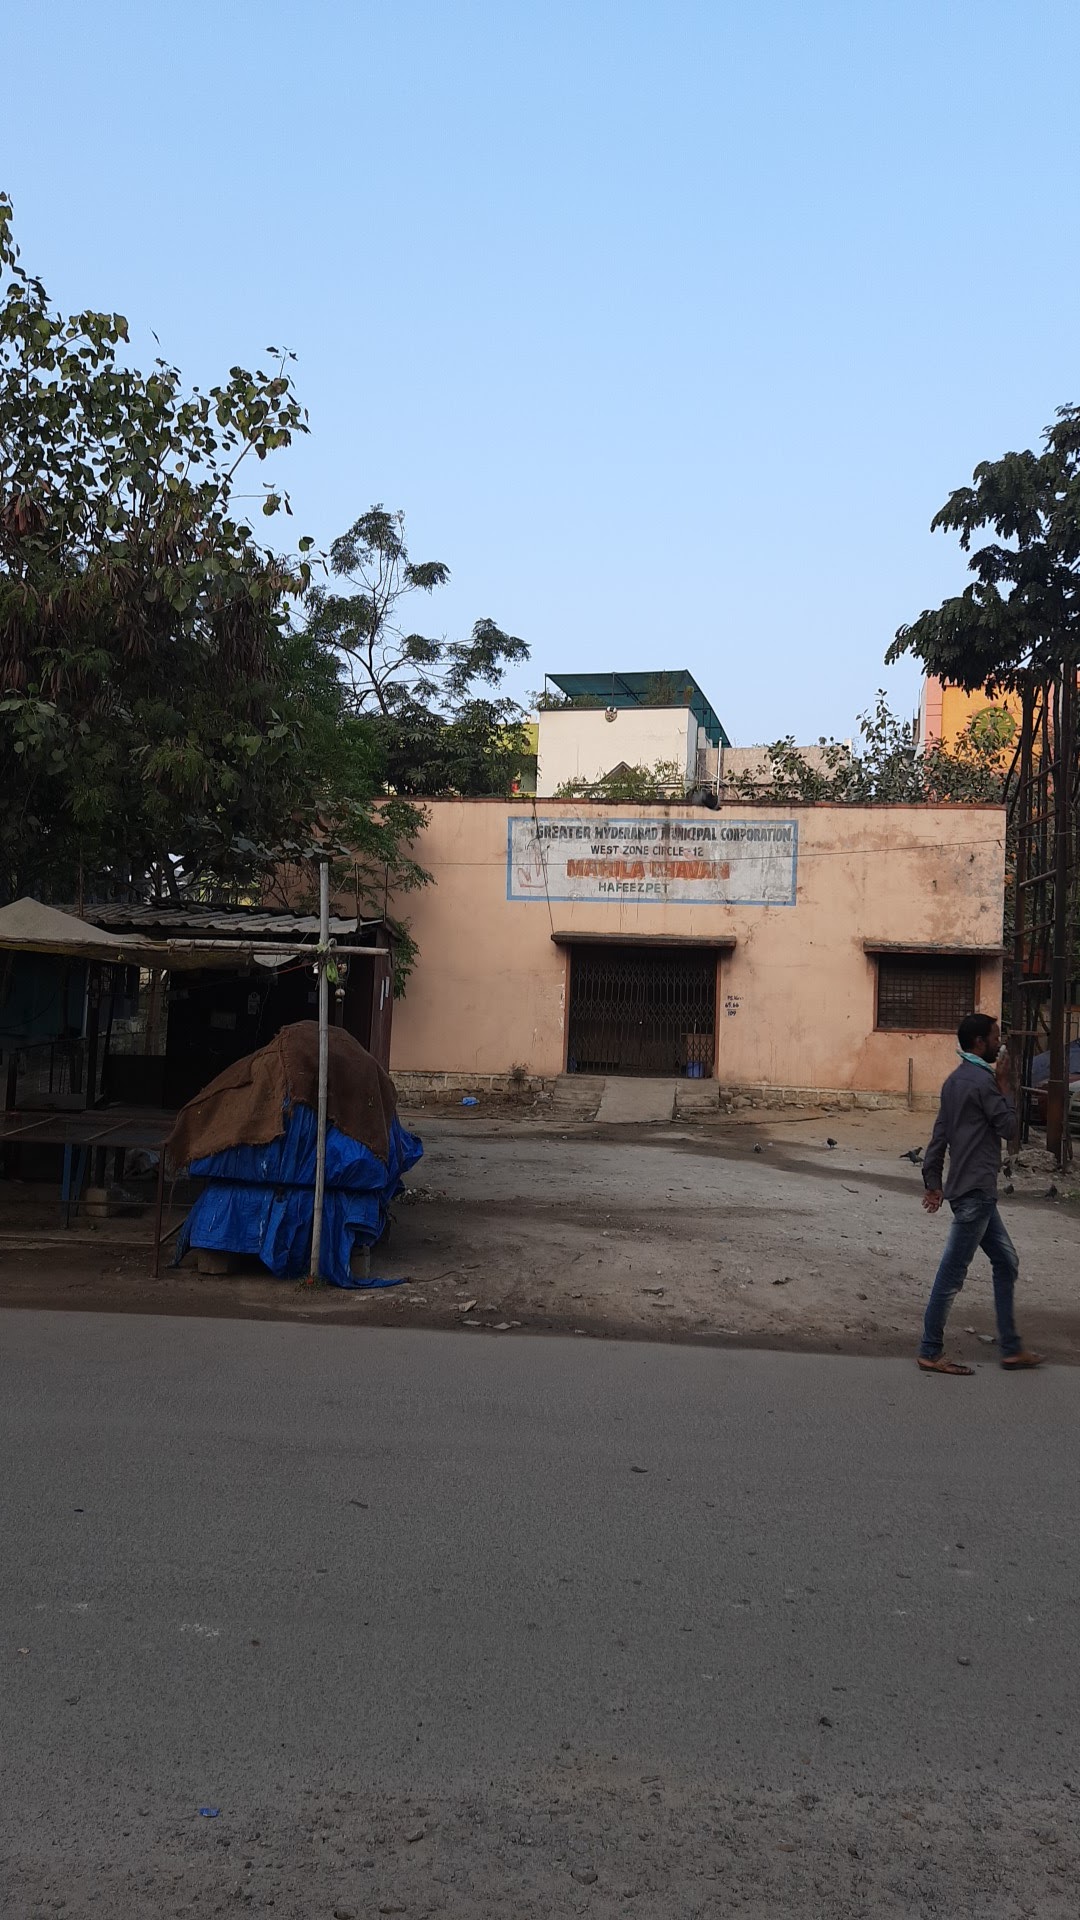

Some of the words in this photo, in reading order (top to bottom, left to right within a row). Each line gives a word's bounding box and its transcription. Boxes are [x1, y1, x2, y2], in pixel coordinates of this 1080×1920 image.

[536, 825, 592, 839] GREATER
[594, 826, 659, 841] HYDERABAD
[590, 844, 619, 855] WEST
[622, 845, 649, 856] ZONE
[598, 881, 670, 894] HAFEEZPET
